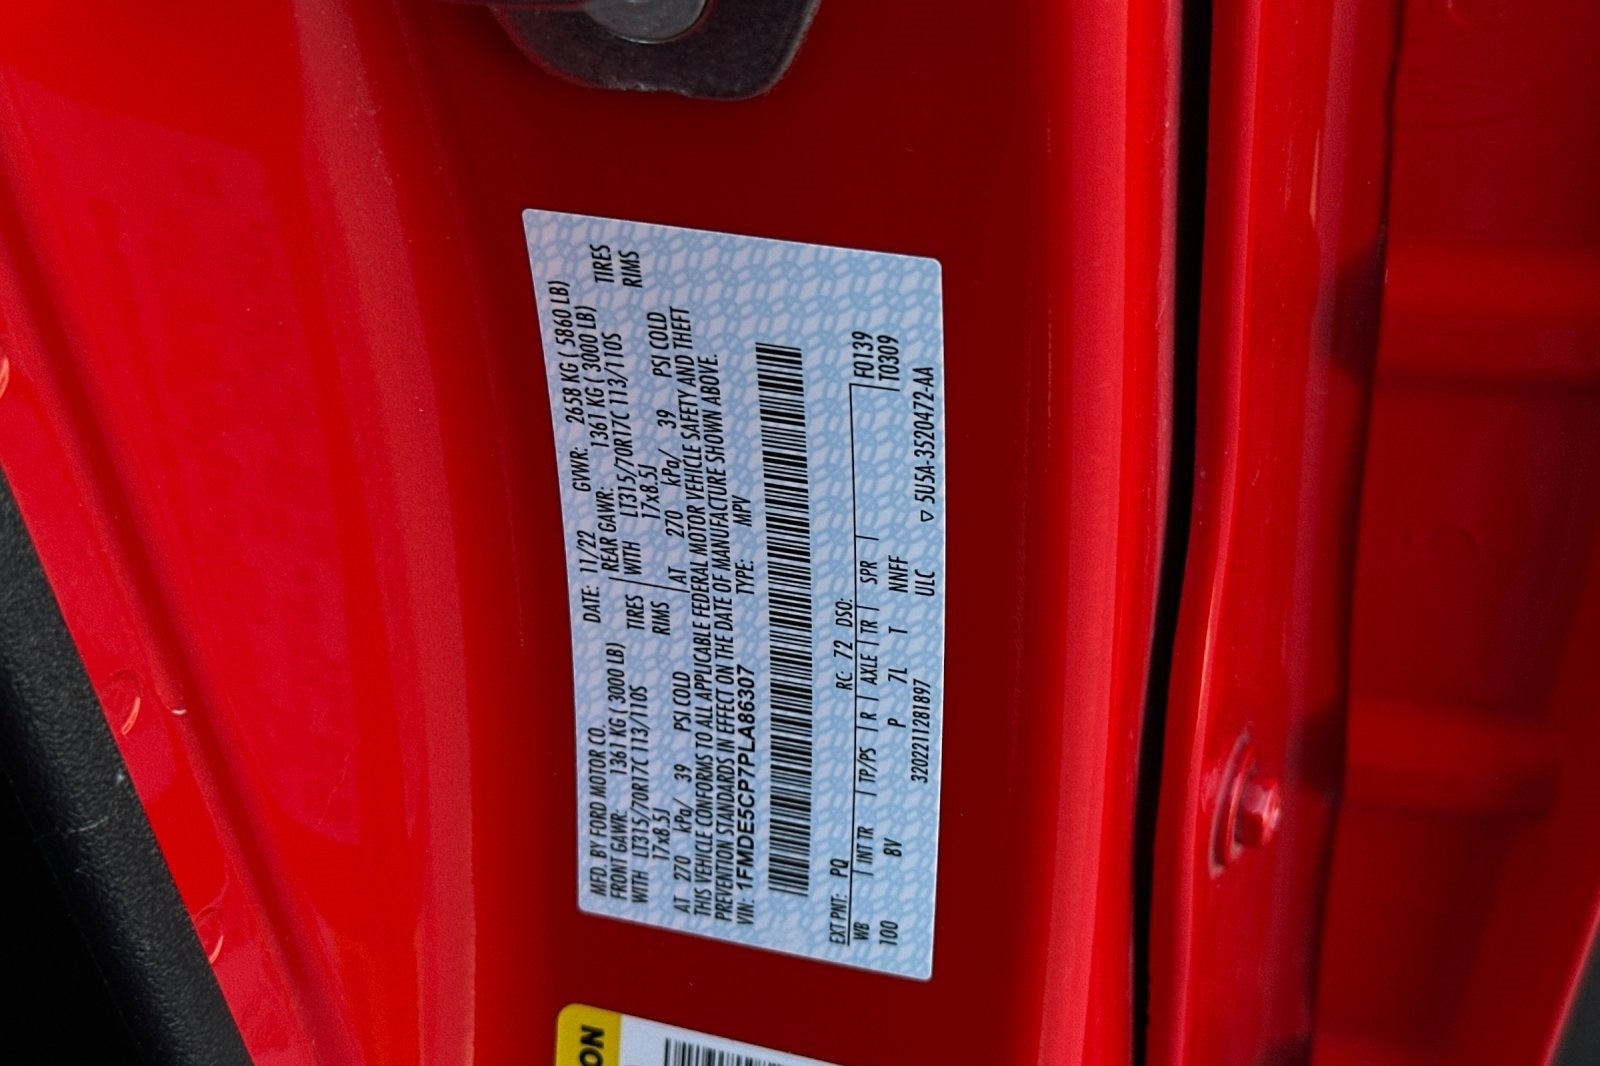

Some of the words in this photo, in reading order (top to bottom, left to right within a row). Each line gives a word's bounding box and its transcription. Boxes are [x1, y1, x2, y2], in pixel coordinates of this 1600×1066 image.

[590, 244, 614, 283] TIRES
[619, 250, 642, 288] RIMS
[548, 280, 570, 304] LB)
[552, 309, 575, 347] 5860
[575, 306, 597, 329] LB)
[647, 312, 668, 350] COLD
[670, 306, 692, 349] THEFT
[578, 334, 601, 372] 3000
[602, 332, 628, 405] 113/110S
[651, 355, 672, 377] PSI
[559, 363, 580, 383] KG
[674, 356, 696, 387] AND
[698, 354, 721, 406] ABOVE.
[562, 388, 584, 424] 2658
[584, 387, 605, 408] KG
[678, 389, 700, 440] SAFETY
[588, 414, 609, 448] 1361
[656, 410, 676, 428] 39
[913, 367, 935, 504] 5U5A-3520472-AA
[702, 410, 725, 464] SHOWN
[570, 447, 591, 492] GVWR:
[611, 411, 638, 517] LT315/70R17C
[682, 444, 704, 500] VEHICLE
[596, 486, 616, 532] GAWR:
[638, 464, 660, 520] 17x8.5J
[665, 510, 684, 538] 270
[706, 467, 730, 570] MANUFACTURE
[732, 495, 752, 527] MPV
[686, 505, 707, 556] MOTOR
[576, 530, 598, 573] 11/22
[600, 537, 619, 572] REAR
[622, 541, 642, 575] WITH
[668, 566, 686, 584] AT
[712, 574, 732, 593] OF
[735, 559, 754, 594] TYPE:
[860, 560, 878, 584] SPR
[888, 555, 908, 593] NNFF
[915, 568, 935, 596] ULC
[582, 585, 600, 623] DATE:
[690, 561, 710, 618] FEDERAL
[625, 594, 644, 630] TIRES
[651, 601, 670, 635] RIMS
[714, 596, 733, 631] DATE
[835, 598, 852, 627] DSO:
[860, 620, 877, 634] TR
[714, 634, 734, 660] THE
[888, 626, 908, 634] T
[606, 643, 626, 665] LB)
[692, 622, 712, 701] APPLICABLE
[833, 640, 852, 660] 72
[607, 668, 626, 704] 3000
[716, 664, 734, 685] ON
[835, 671, 852, 690] RC:
[860, 654, 877, 685] AXLE
[888, 668, 907, 684] 7L
[672, 671, 690, 706] COLD
[608, 718, 626, 737] KG
[629, 685, 650, 752] 113/110S
[673, 711, 691, 732] PSI
[694, 706, 713, 728] ALL
[715, 688, 734, 734] EFFECT
[860, 712, 876, 720] R
[888, 718, 906, 728] P
[588, 724, 606, 745] CO.
[695, 732, 713, 748] TO
[716, 739, 735, 753] IN
[912, 679, 931, 784] 3202211281897
[588, 749, 607, 798] MOTOR
[610, 742, 627, 775] 1361
[674, 764, 691, 782] 39
[858, 747, 876, 784] TP/PS
[695, 753, 713, 827] CONFORMS
[737, 664, 756, 891] 1FMDE5CP7PLA86307
[630, 757, 650, 858] LT315/70R17C
[716, 758, 735, 836] STANDARDS
[590, 801, 607, 837] FORD
[610, 810, 627, 852] GAWR:
[652, 807, 670, 861] 17x8.5J
[858, 826, 874, 840] TR
[590, 840, 606, 859] BY
[694, 831, 713, 884] VEHICLE
[857, 843, 873, 864] INT
[590, 864, 607, 896] MFD.
[610, 856, 627, 900] FRONT
[674, 855, 691, 882] 270
[715, 841, 734, 922] PREVENTION
[830, 858, 848, 878] PQ
[632, 870, 648, 903] WITH
[694, 888, 712, 916] THIS
[674, 896, 690, 913] AT
[737, 898, 754, 925] VIN:
[830, 894, 848, 919] PNT:
[830, 922, 846, 944] EXT
[854, 922, 869, 940] WB
[880, 920, 898, 946] 100
